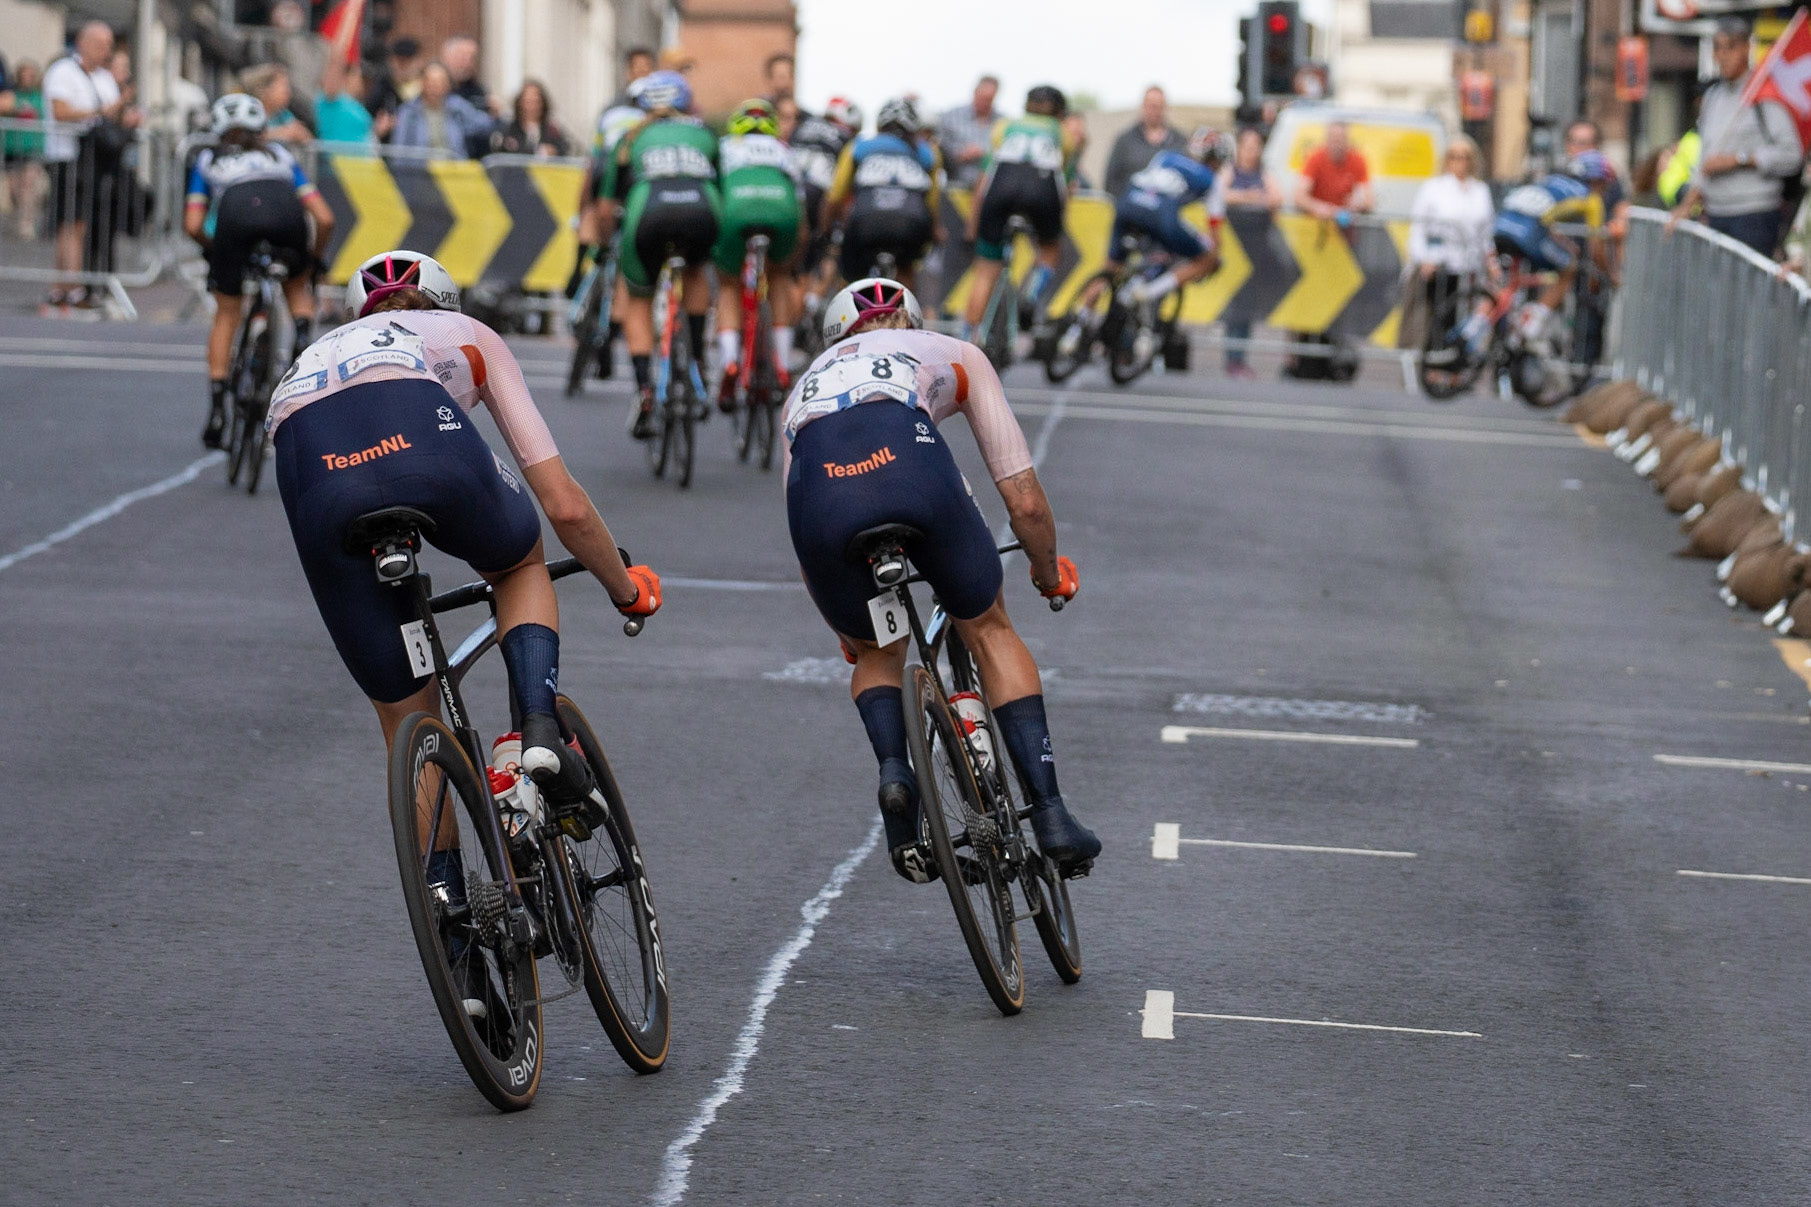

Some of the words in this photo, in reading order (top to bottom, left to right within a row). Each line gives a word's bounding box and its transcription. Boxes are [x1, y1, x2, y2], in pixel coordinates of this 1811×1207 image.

[371, 329, 394, 347] 3
[360, 353, 410, 364] SCOTLAND
[871, 358, 893, 379] 8
[801, 378, 820, 402] 8
[439, 422, 462, 431] AGU
[915, 435, 935, 443] AGU
[321, 433, 412, 470] TeamNL
[823, 446, 896, 478] TeamNL
[886, 610, 897, 634] 8
[416, 641, 427, 668] 3
[440, 675, 463, 728] TARMAC
